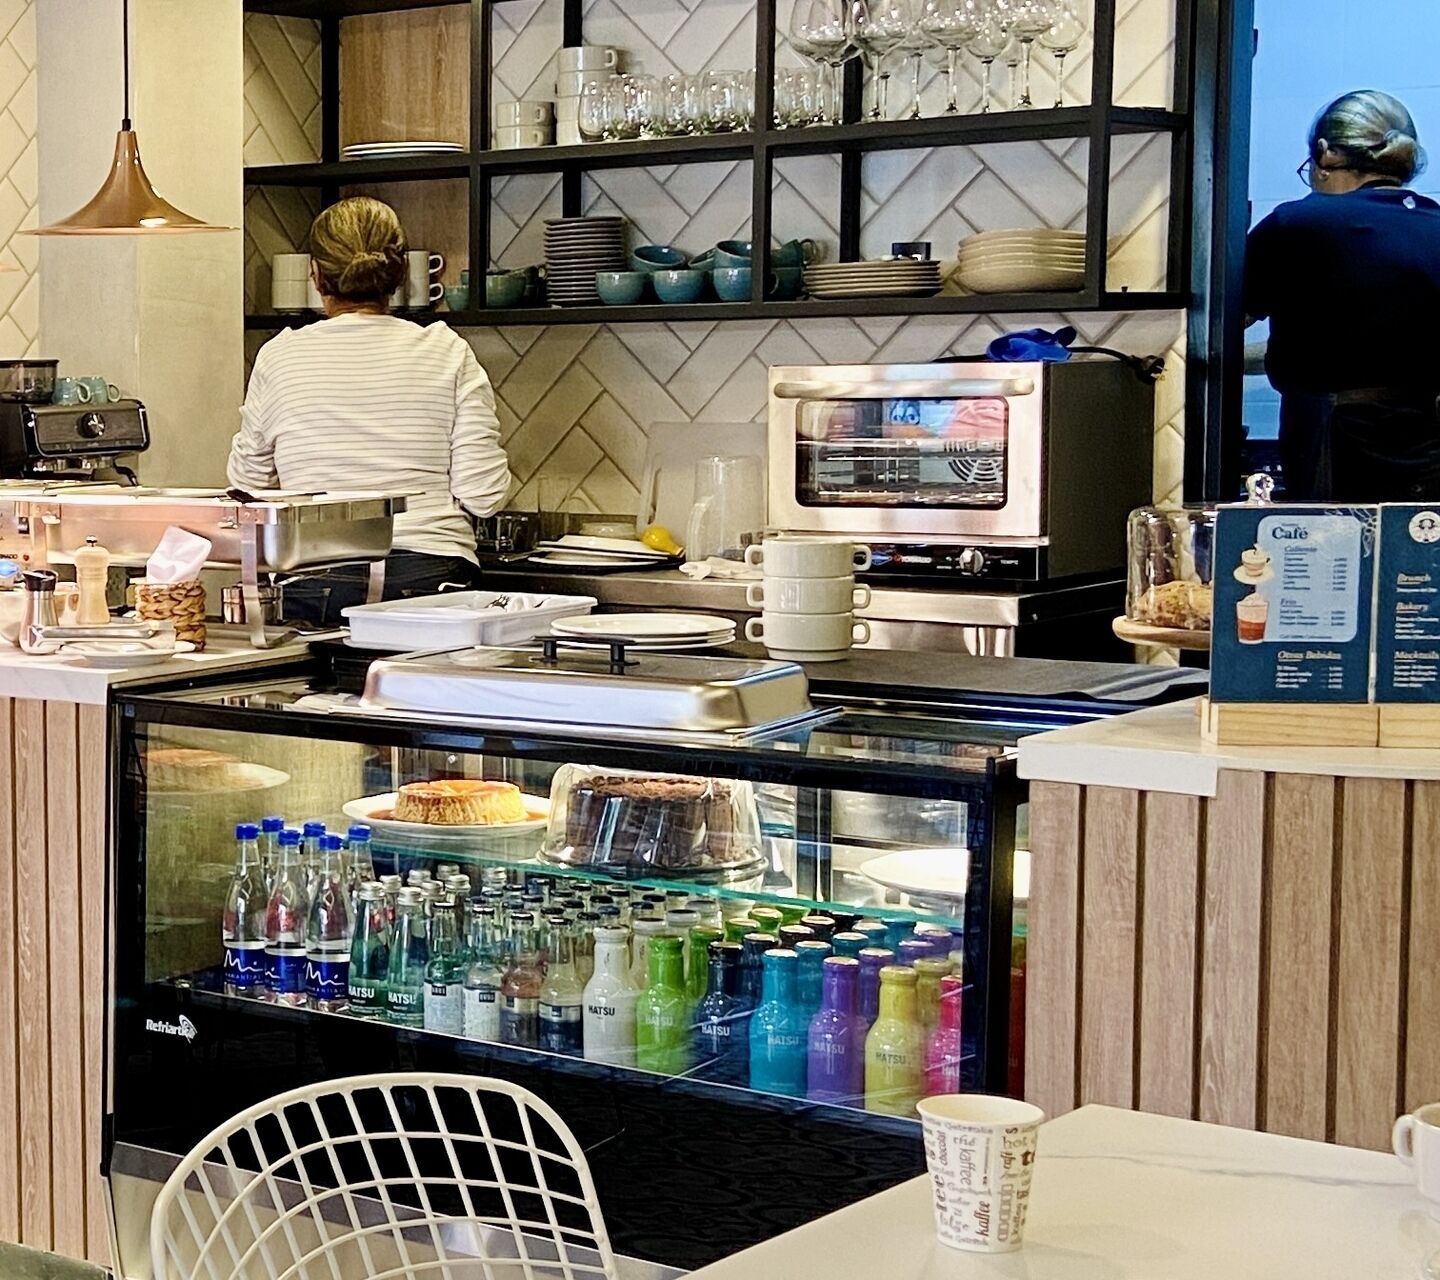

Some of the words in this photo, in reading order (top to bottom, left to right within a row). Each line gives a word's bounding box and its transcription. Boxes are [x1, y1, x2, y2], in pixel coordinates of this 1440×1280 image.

[1272, 526, 1309, 540] Café
[588, 1005, 615, 1017] HATSU
[702, 1023, 730, 1036] HATSU
[876, 1052, 906, 1065] HATSU
[973, 1201, 991, 1237] kaffee
